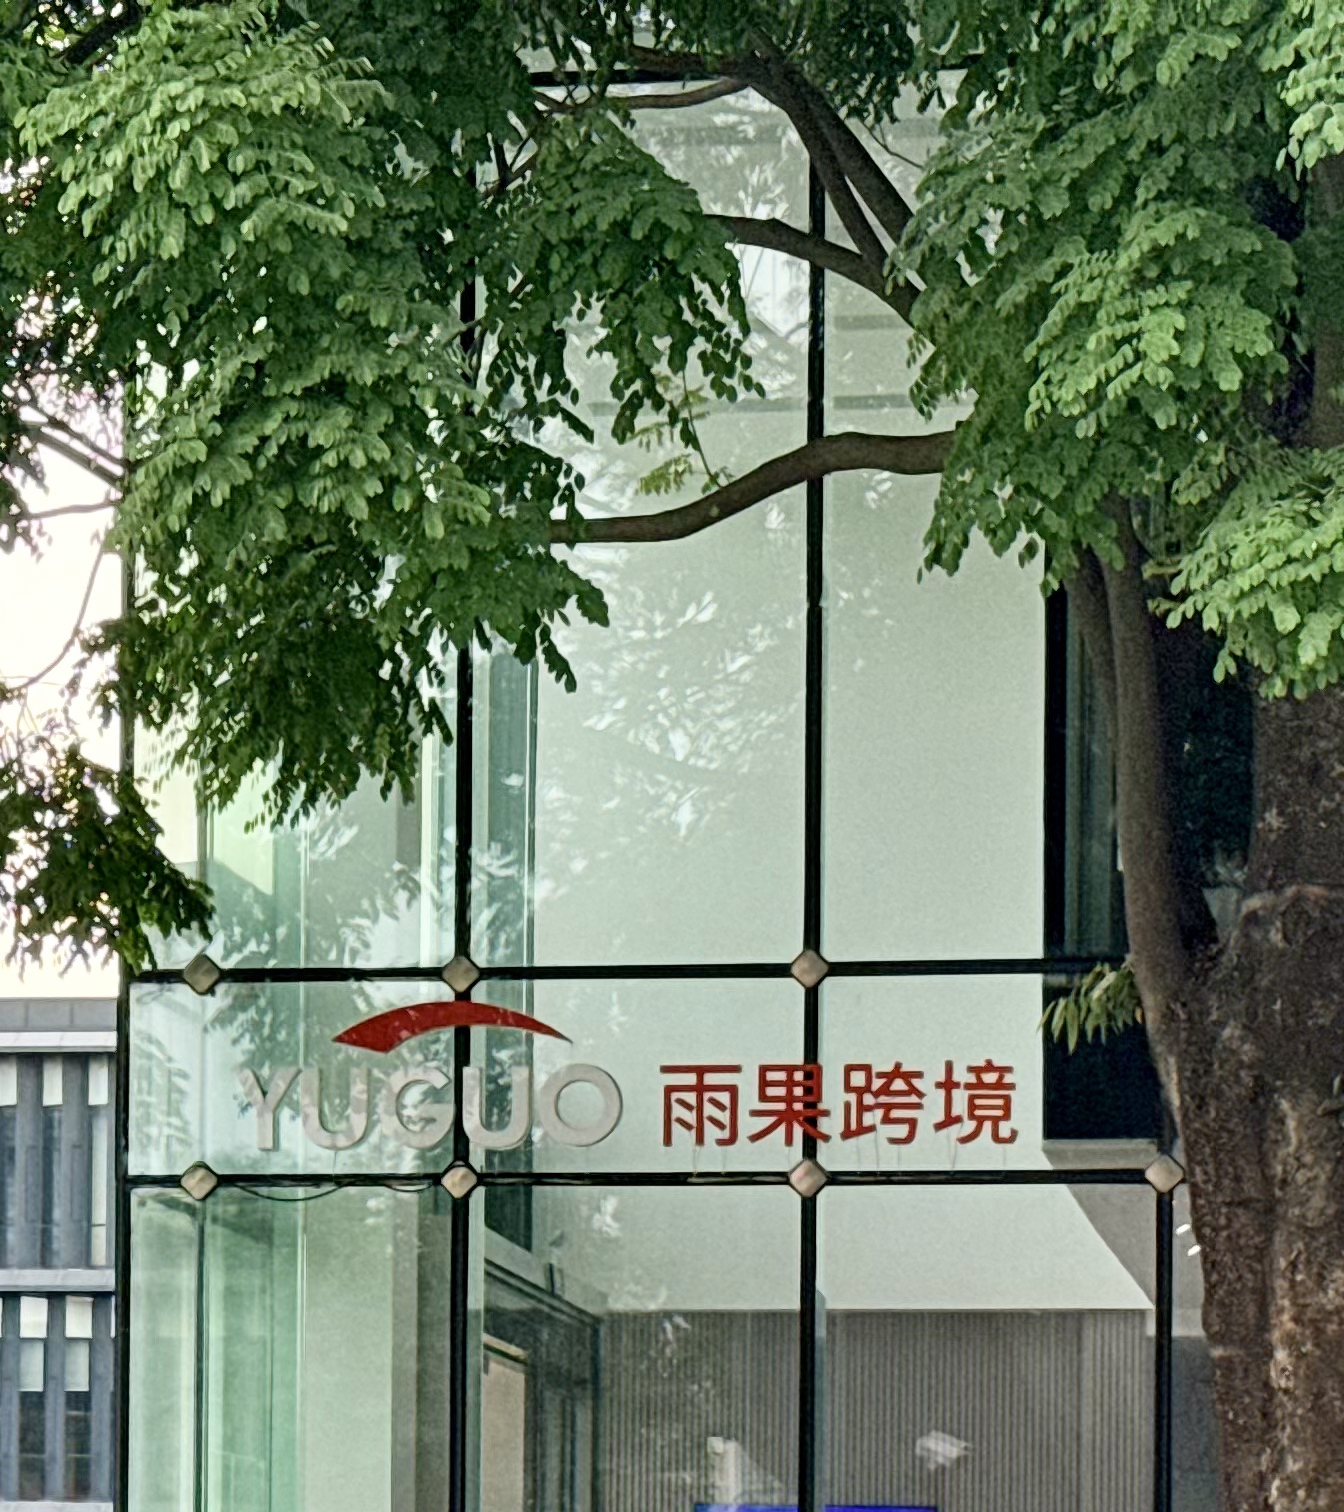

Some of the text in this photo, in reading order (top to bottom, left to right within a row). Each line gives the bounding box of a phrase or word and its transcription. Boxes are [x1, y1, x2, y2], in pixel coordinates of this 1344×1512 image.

[237, 1058, 1019, 1152] YUGUO 雨果跨境
